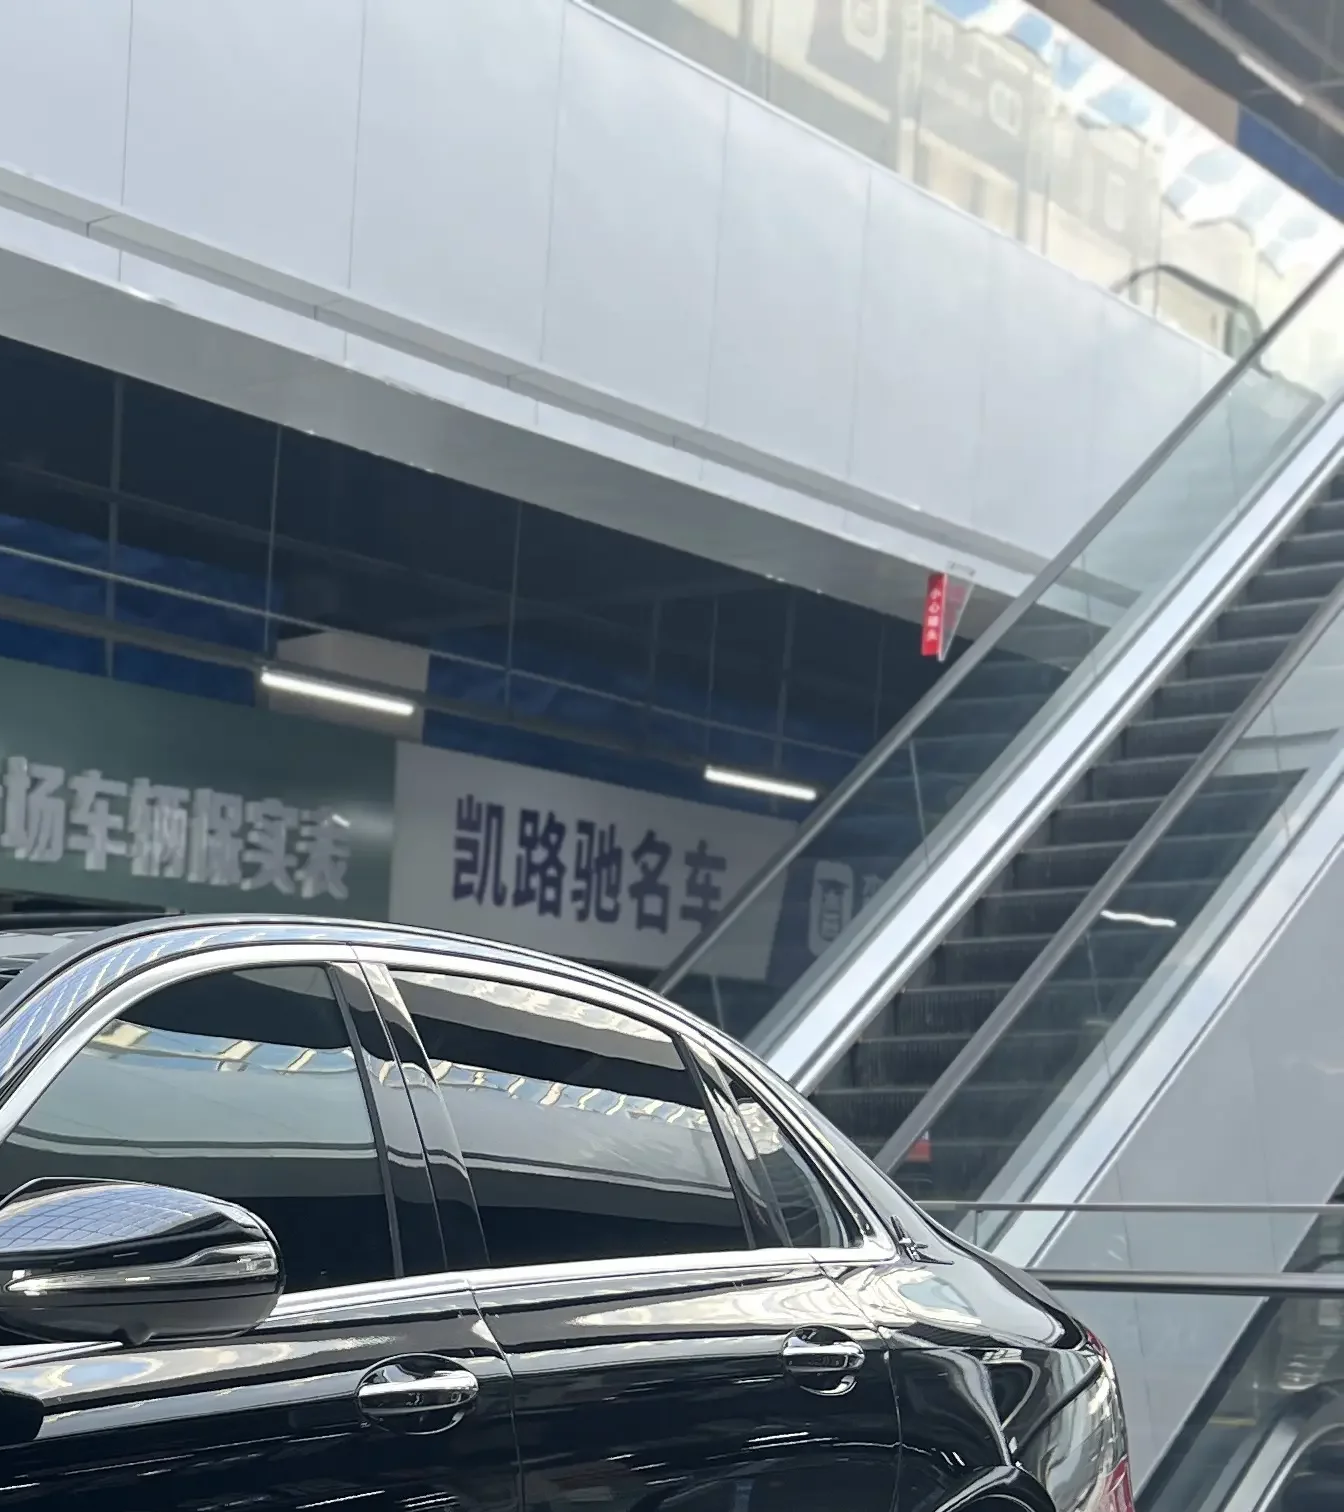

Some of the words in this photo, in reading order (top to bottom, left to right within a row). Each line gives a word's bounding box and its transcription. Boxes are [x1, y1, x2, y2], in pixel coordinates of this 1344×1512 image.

[451, 793, 728, 935] 凯路驰名车
